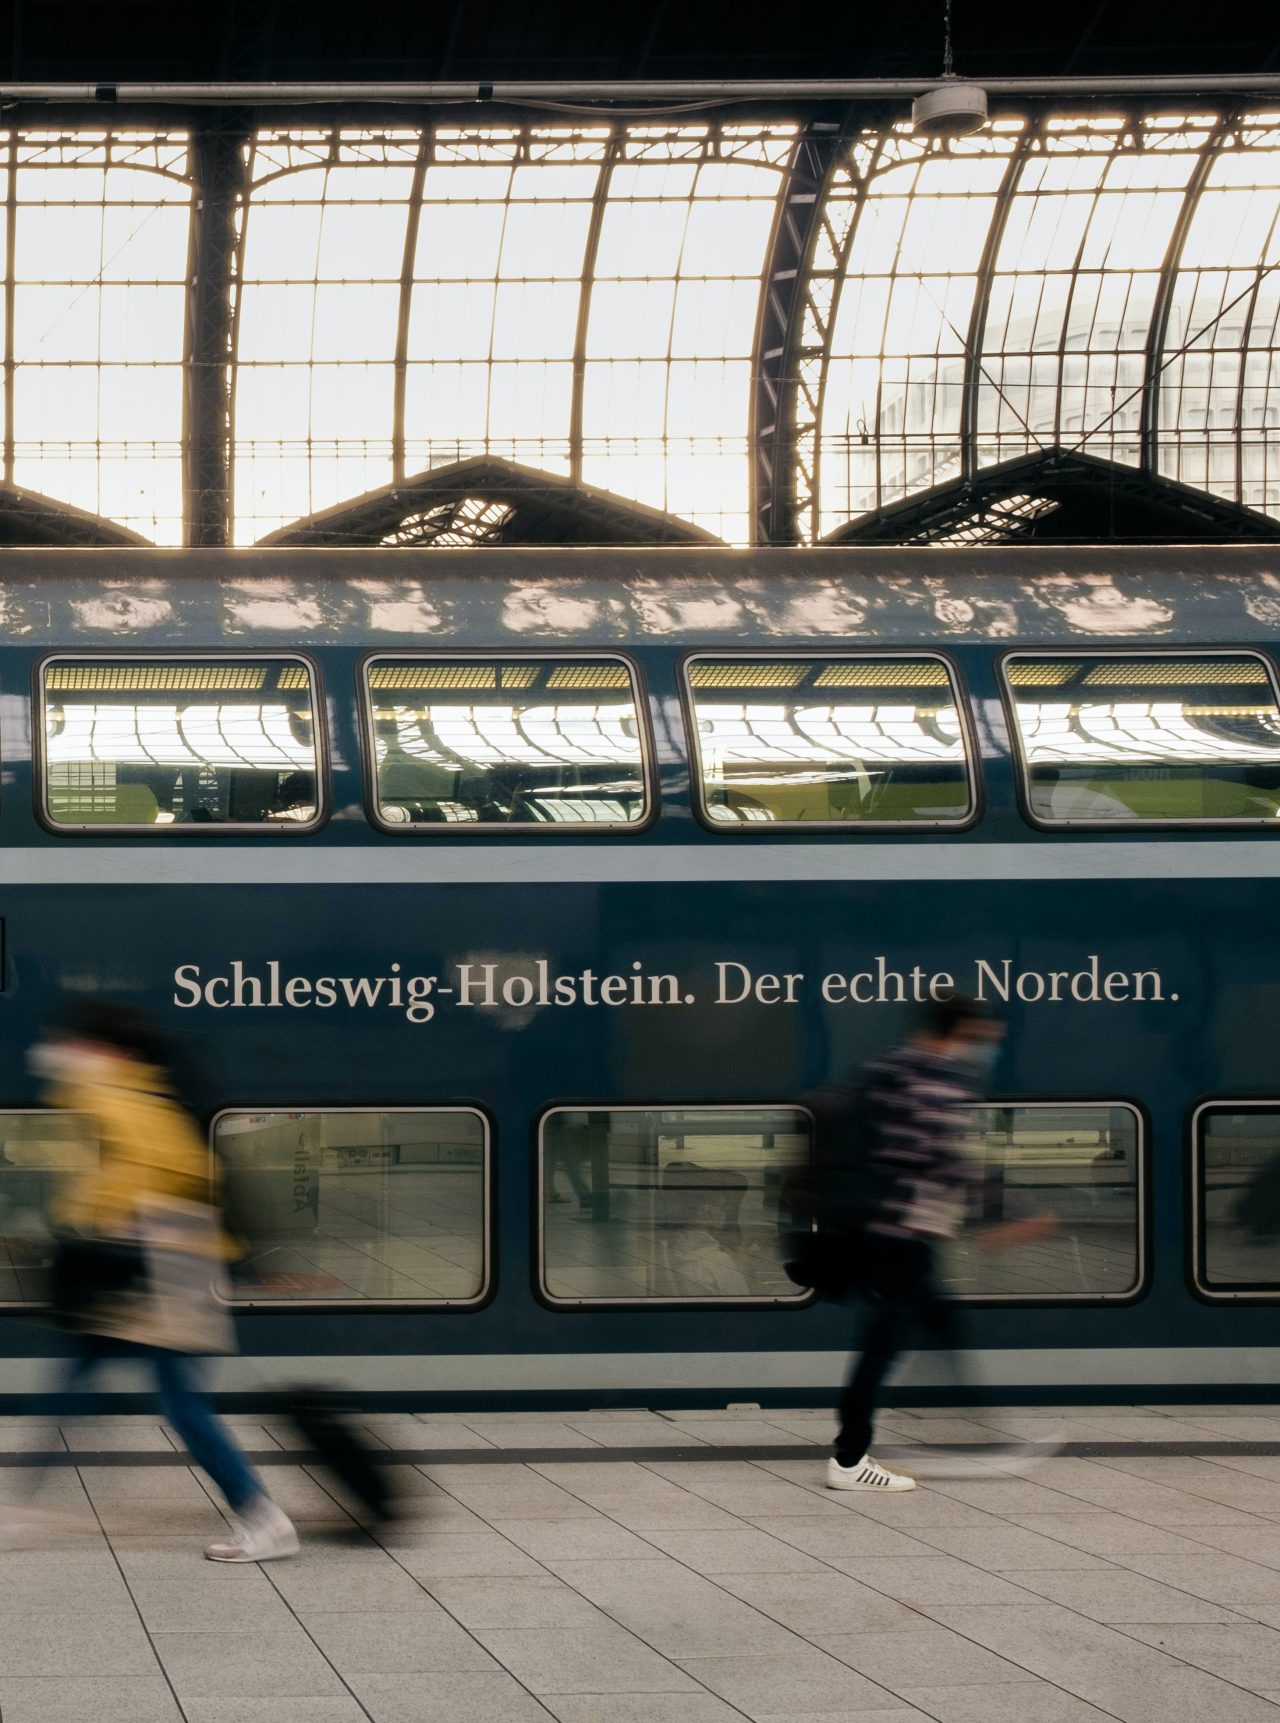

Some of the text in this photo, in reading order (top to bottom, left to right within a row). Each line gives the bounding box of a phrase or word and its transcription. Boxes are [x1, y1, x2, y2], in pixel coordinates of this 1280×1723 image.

[173, 955, 1180, 1024] Schleswig-Holstein. Der echte Norden.
